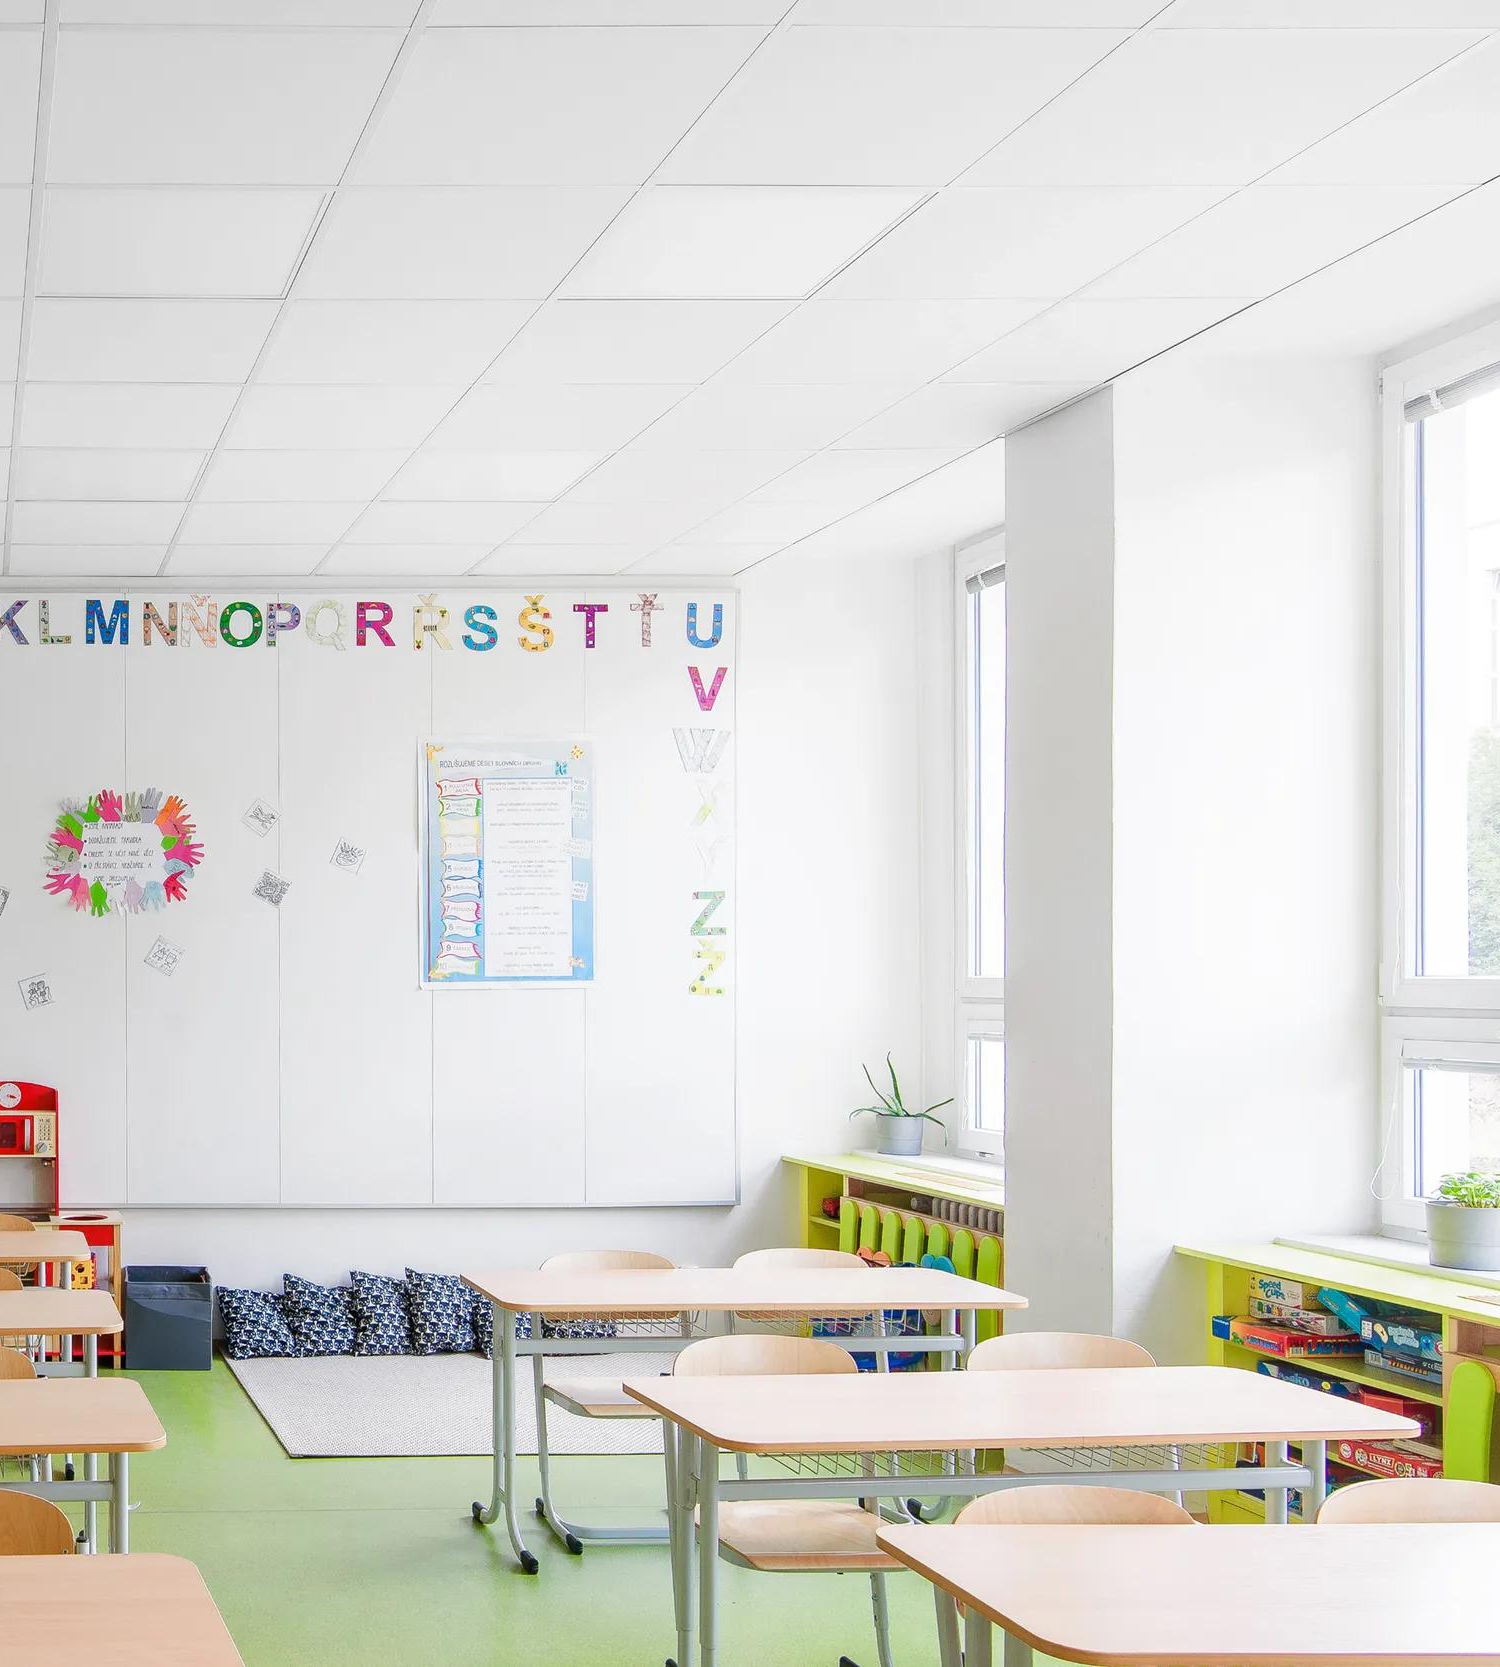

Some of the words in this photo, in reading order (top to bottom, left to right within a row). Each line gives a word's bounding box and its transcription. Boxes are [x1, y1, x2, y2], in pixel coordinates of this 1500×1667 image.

[39, 600, 72, 644] L
[86, 600, 129, 644] M
[143, 602, 177, 647] N
[180, 594, 218, 647] Ň
[220, 602, 263, 647] O
[266, 603, 301, 647] P
[301, 600, 346, 650] Q
[356, 602, 395, 647] R
[413, 594, 454, 651] Ř
[463, 603, 497, 651] S
[518, 595, 554, 652] Š
[573, 604, 608, 648] T
[629, 593, 664, 647] Ť
[686, 603, 721, 648] U
[687, 667, 728, 711] V
[672, 728, 730, 772] W
[691, 891, 726, 936] Z
[689, 939, 725, 995] Ž
[1259, 1279, 1281, 1292] Speed
[1265, 1289, 1286, 1300] Cups
